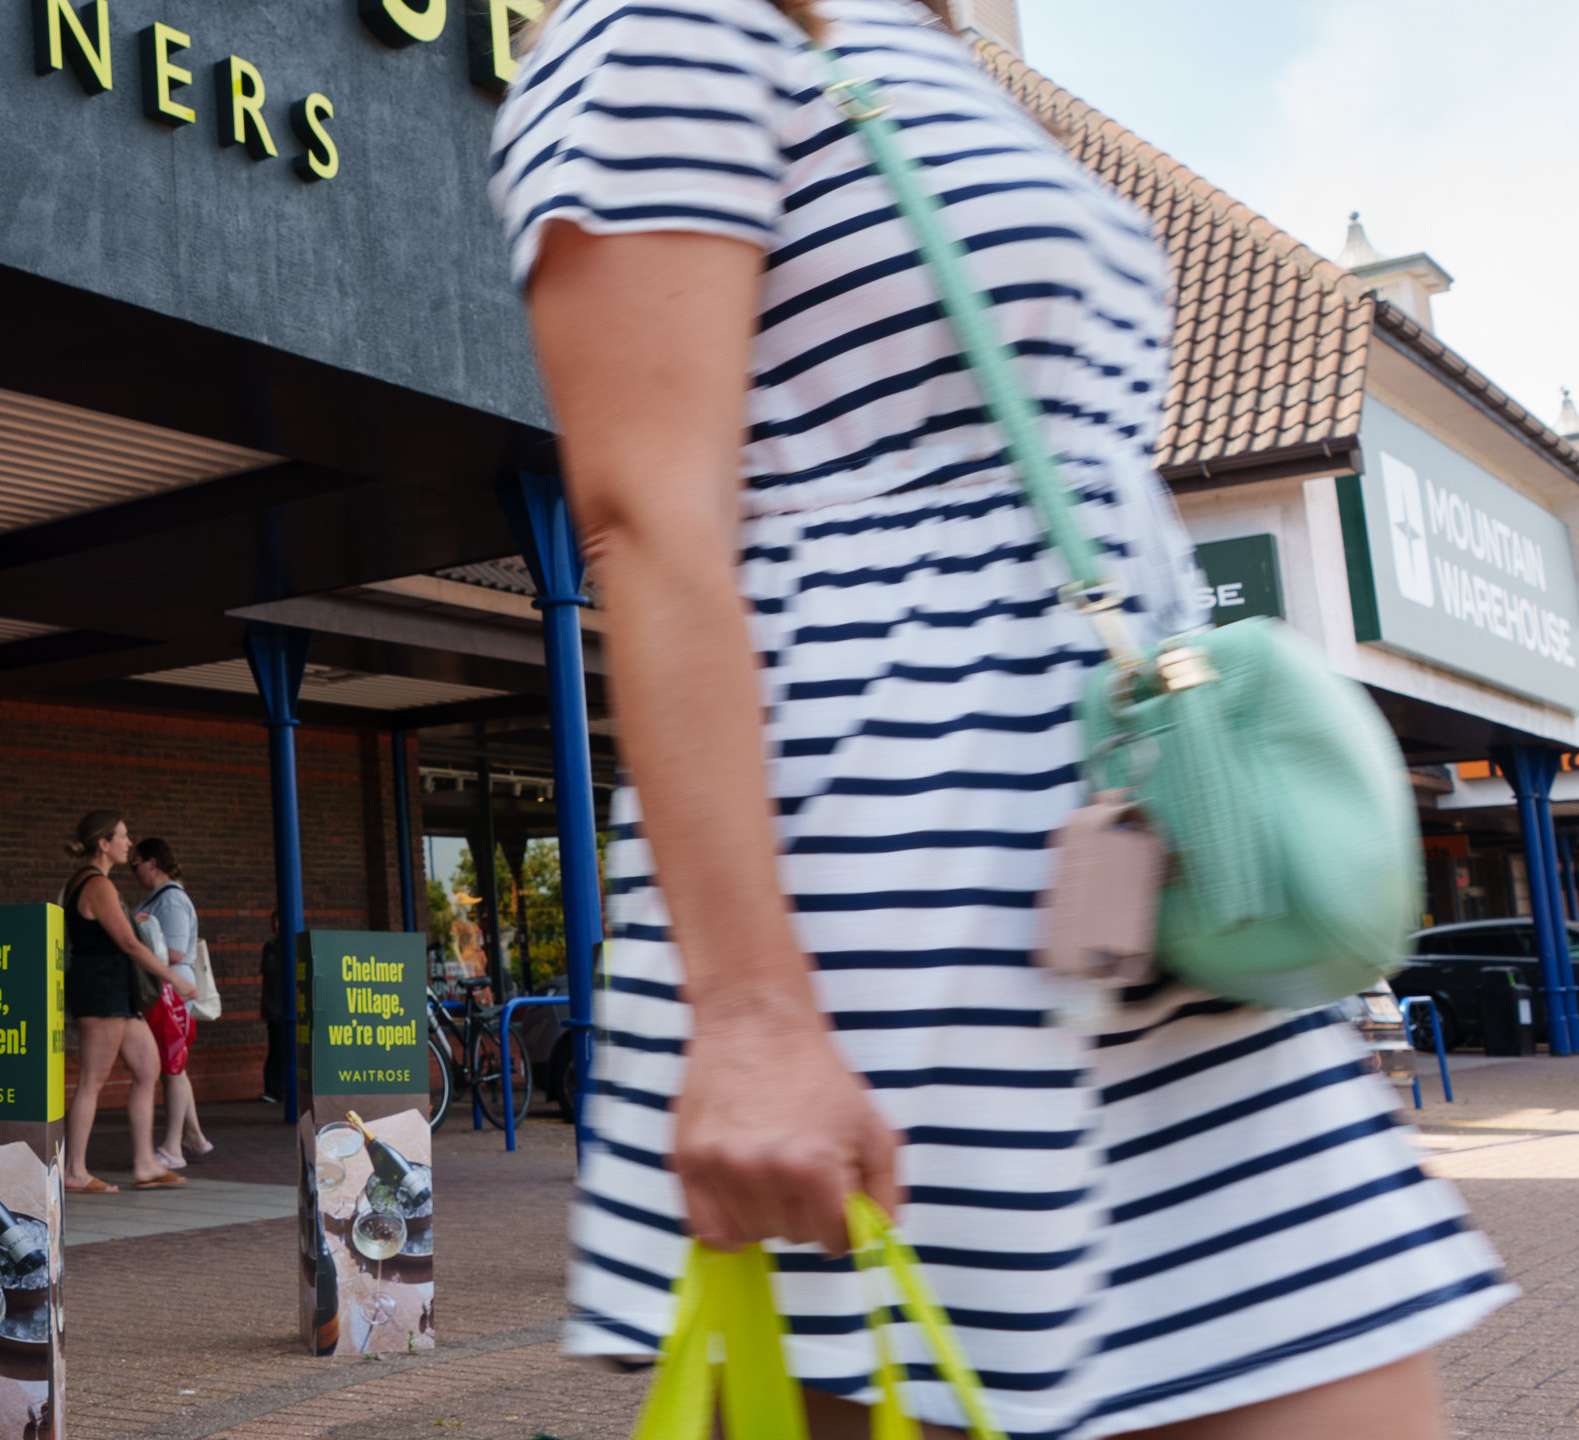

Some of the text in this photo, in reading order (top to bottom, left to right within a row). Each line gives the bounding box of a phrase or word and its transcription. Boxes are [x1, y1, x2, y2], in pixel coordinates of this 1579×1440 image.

[1425, 478, 1547, 593] MOUNTAIN
[1434, 556, 1576, 669] WAREHOUSE
[341, 955, 405, 982] Chelmer
[346, 987, 405, 1020] Village,
[376, 1019, 417, 1052] open!
[337, 1069, 411, 1082] WAITROSE
